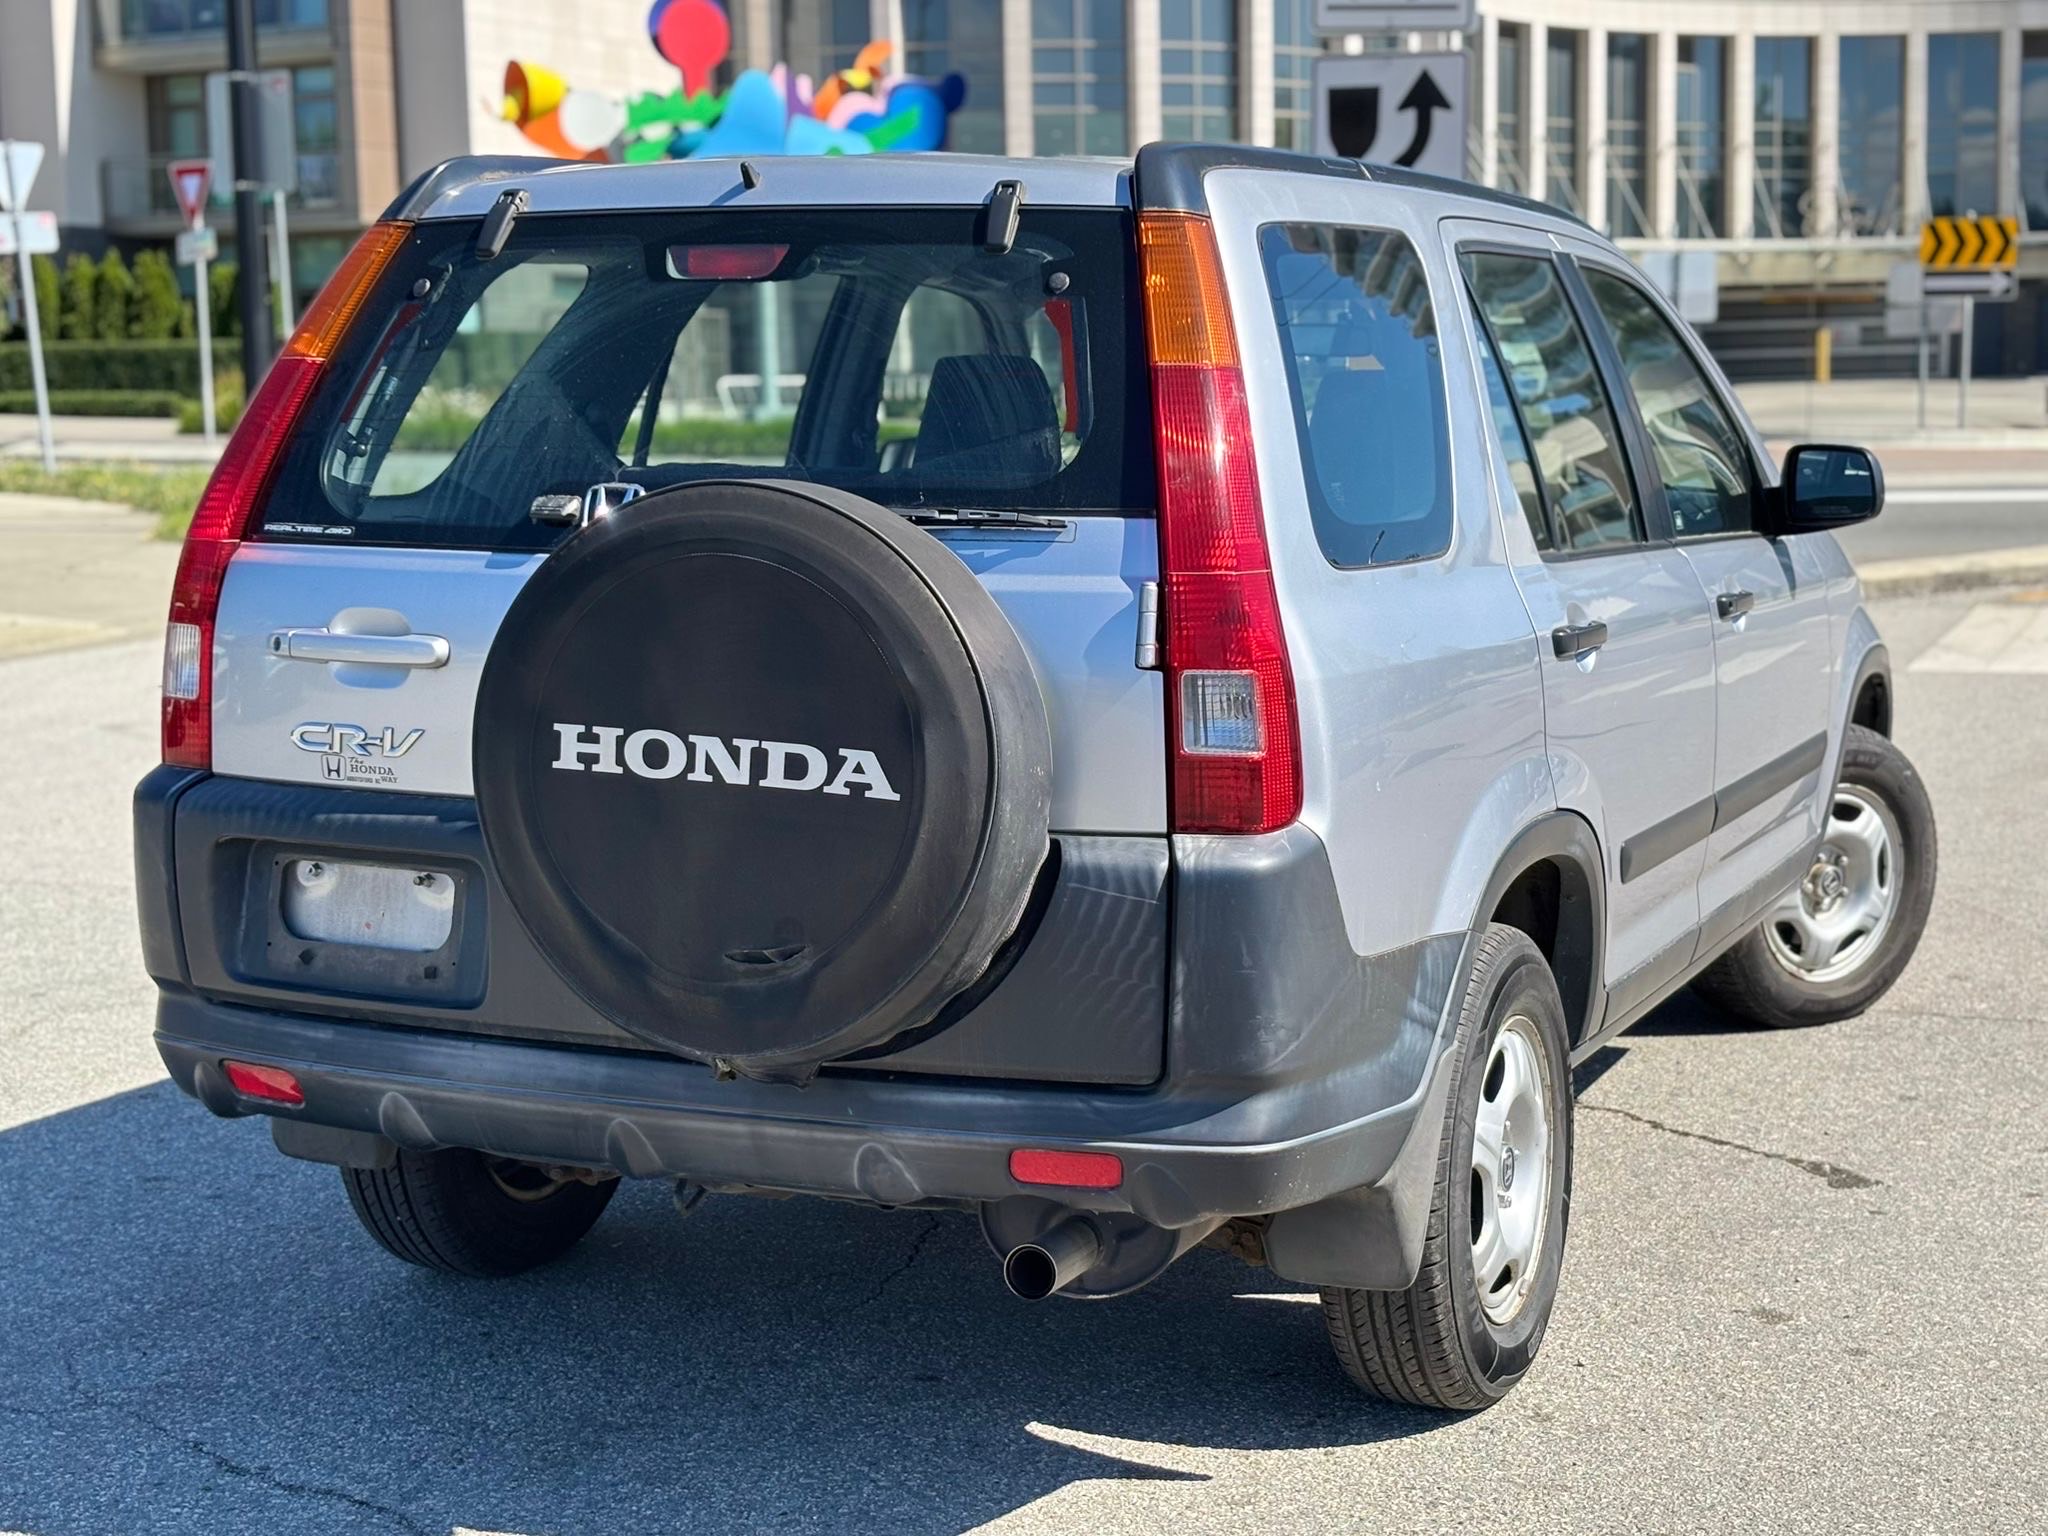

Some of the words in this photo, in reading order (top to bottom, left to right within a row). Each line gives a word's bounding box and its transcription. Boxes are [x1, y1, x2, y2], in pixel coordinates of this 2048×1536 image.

[290, 721, 426, 758] CR-V
[350, 764, 394, 776] HONDA
[552, 722, 901, 802] HONDA
[380, 775, 399, 784] WAY
